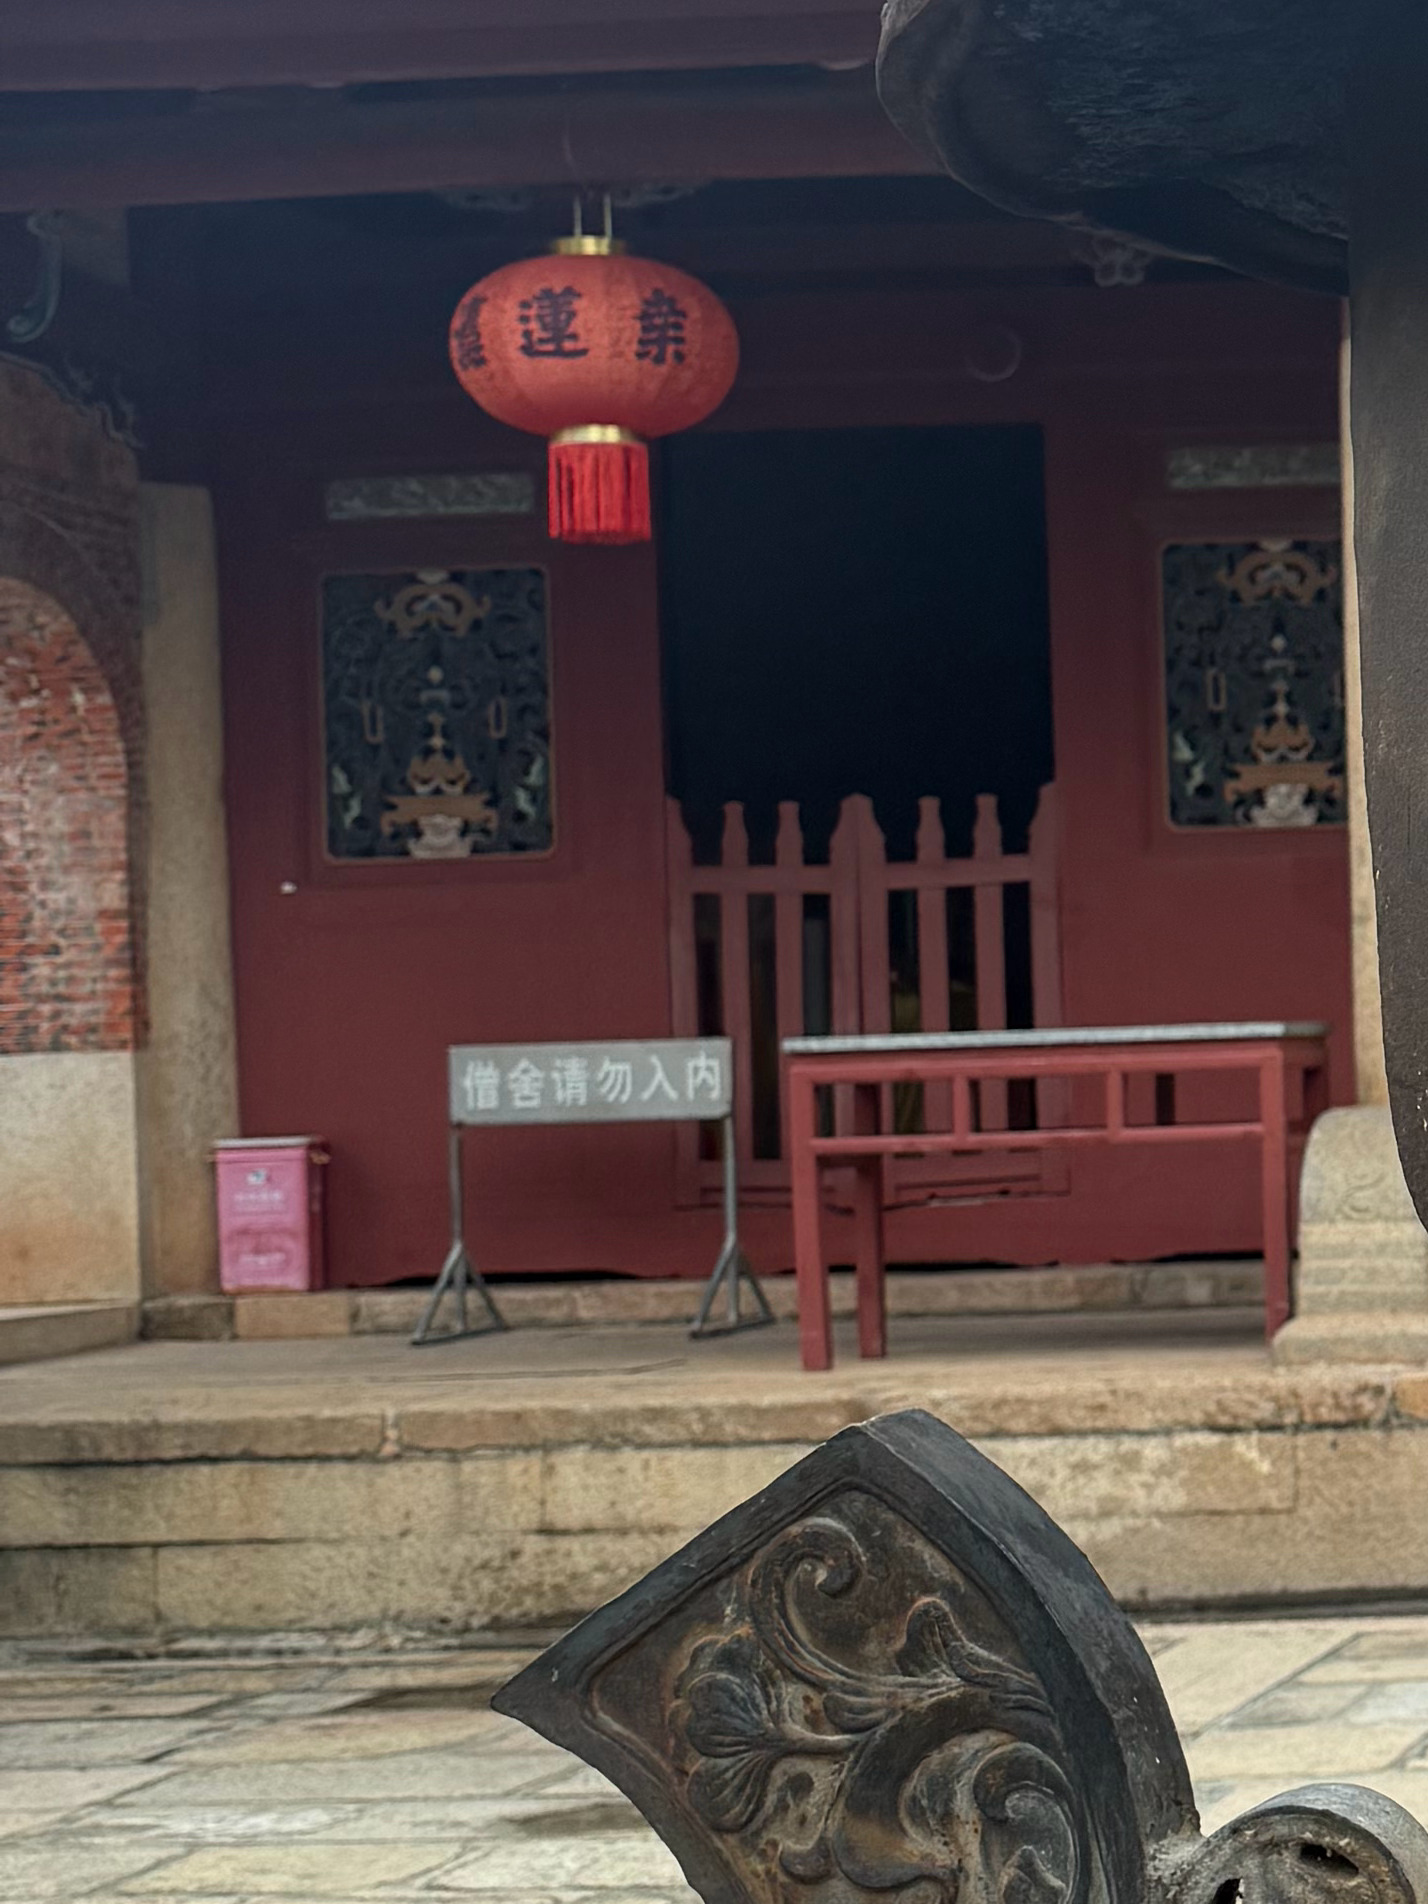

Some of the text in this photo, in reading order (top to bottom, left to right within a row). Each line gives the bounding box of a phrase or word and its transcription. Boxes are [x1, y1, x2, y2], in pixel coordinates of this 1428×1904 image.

[463, 1049, 722, 1111] 僧舍请勿入内
